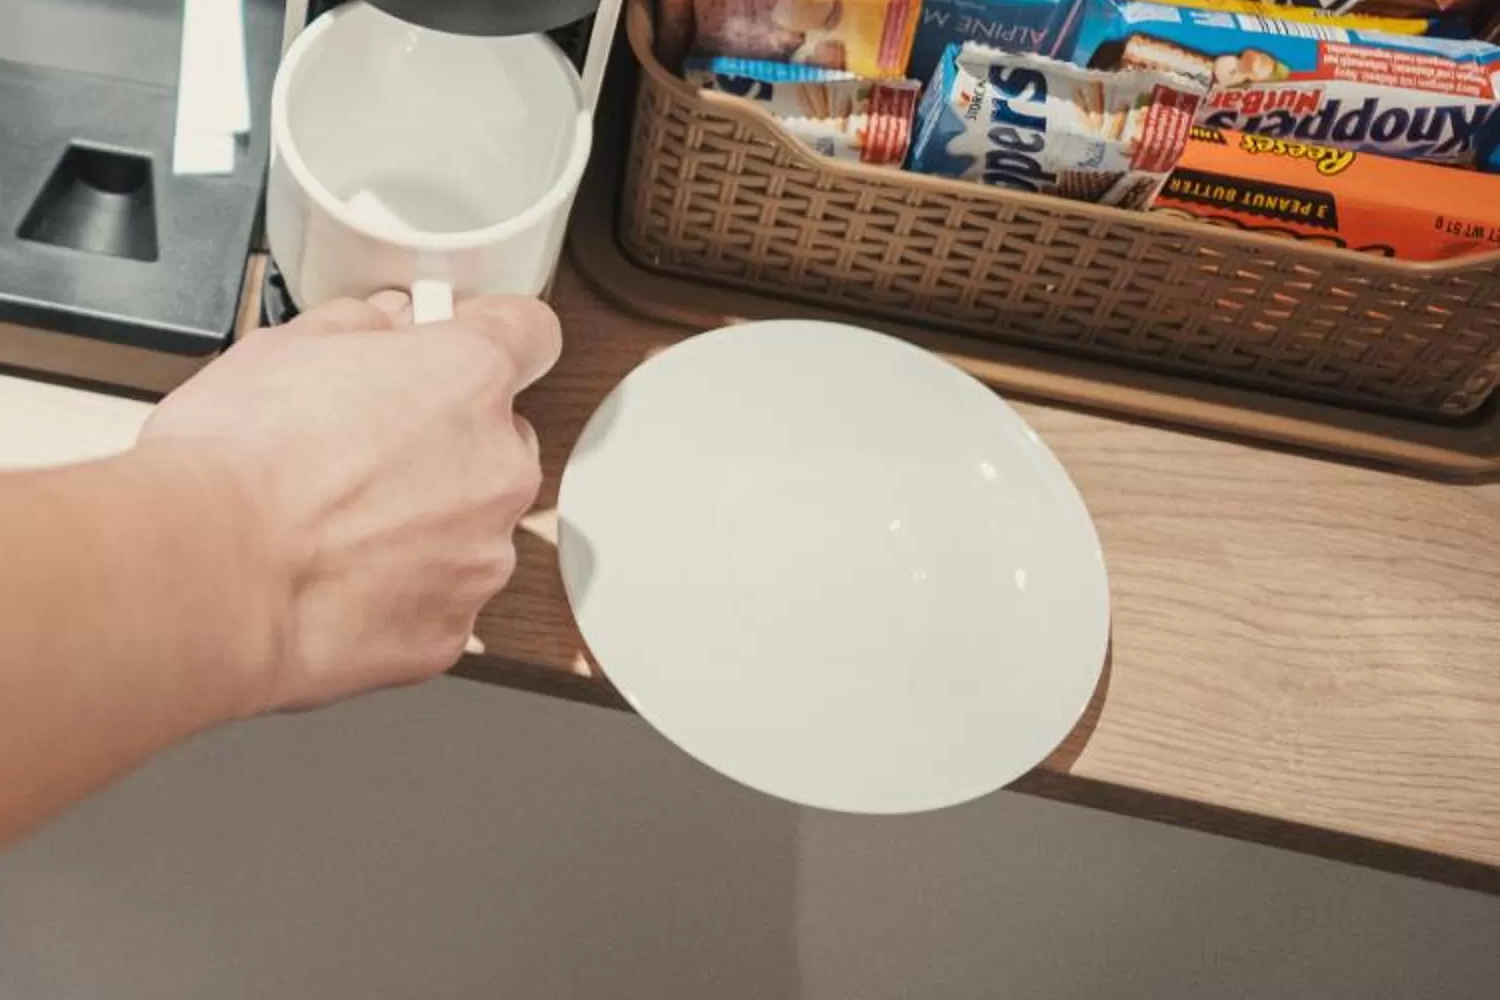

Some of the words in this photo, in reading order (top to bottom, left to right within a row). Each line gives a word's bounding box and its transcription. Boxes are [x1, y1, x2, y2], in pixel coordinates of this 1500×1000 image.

[1206, 88, 1323, 115] NutBar
[1204, 98, 1494, 154] Knoppers
[1168, 175, 1238, 202] BUTTER
[1241, 190, 1312, 216] PEANUT
[1316, 203, 1329, 219] 3
